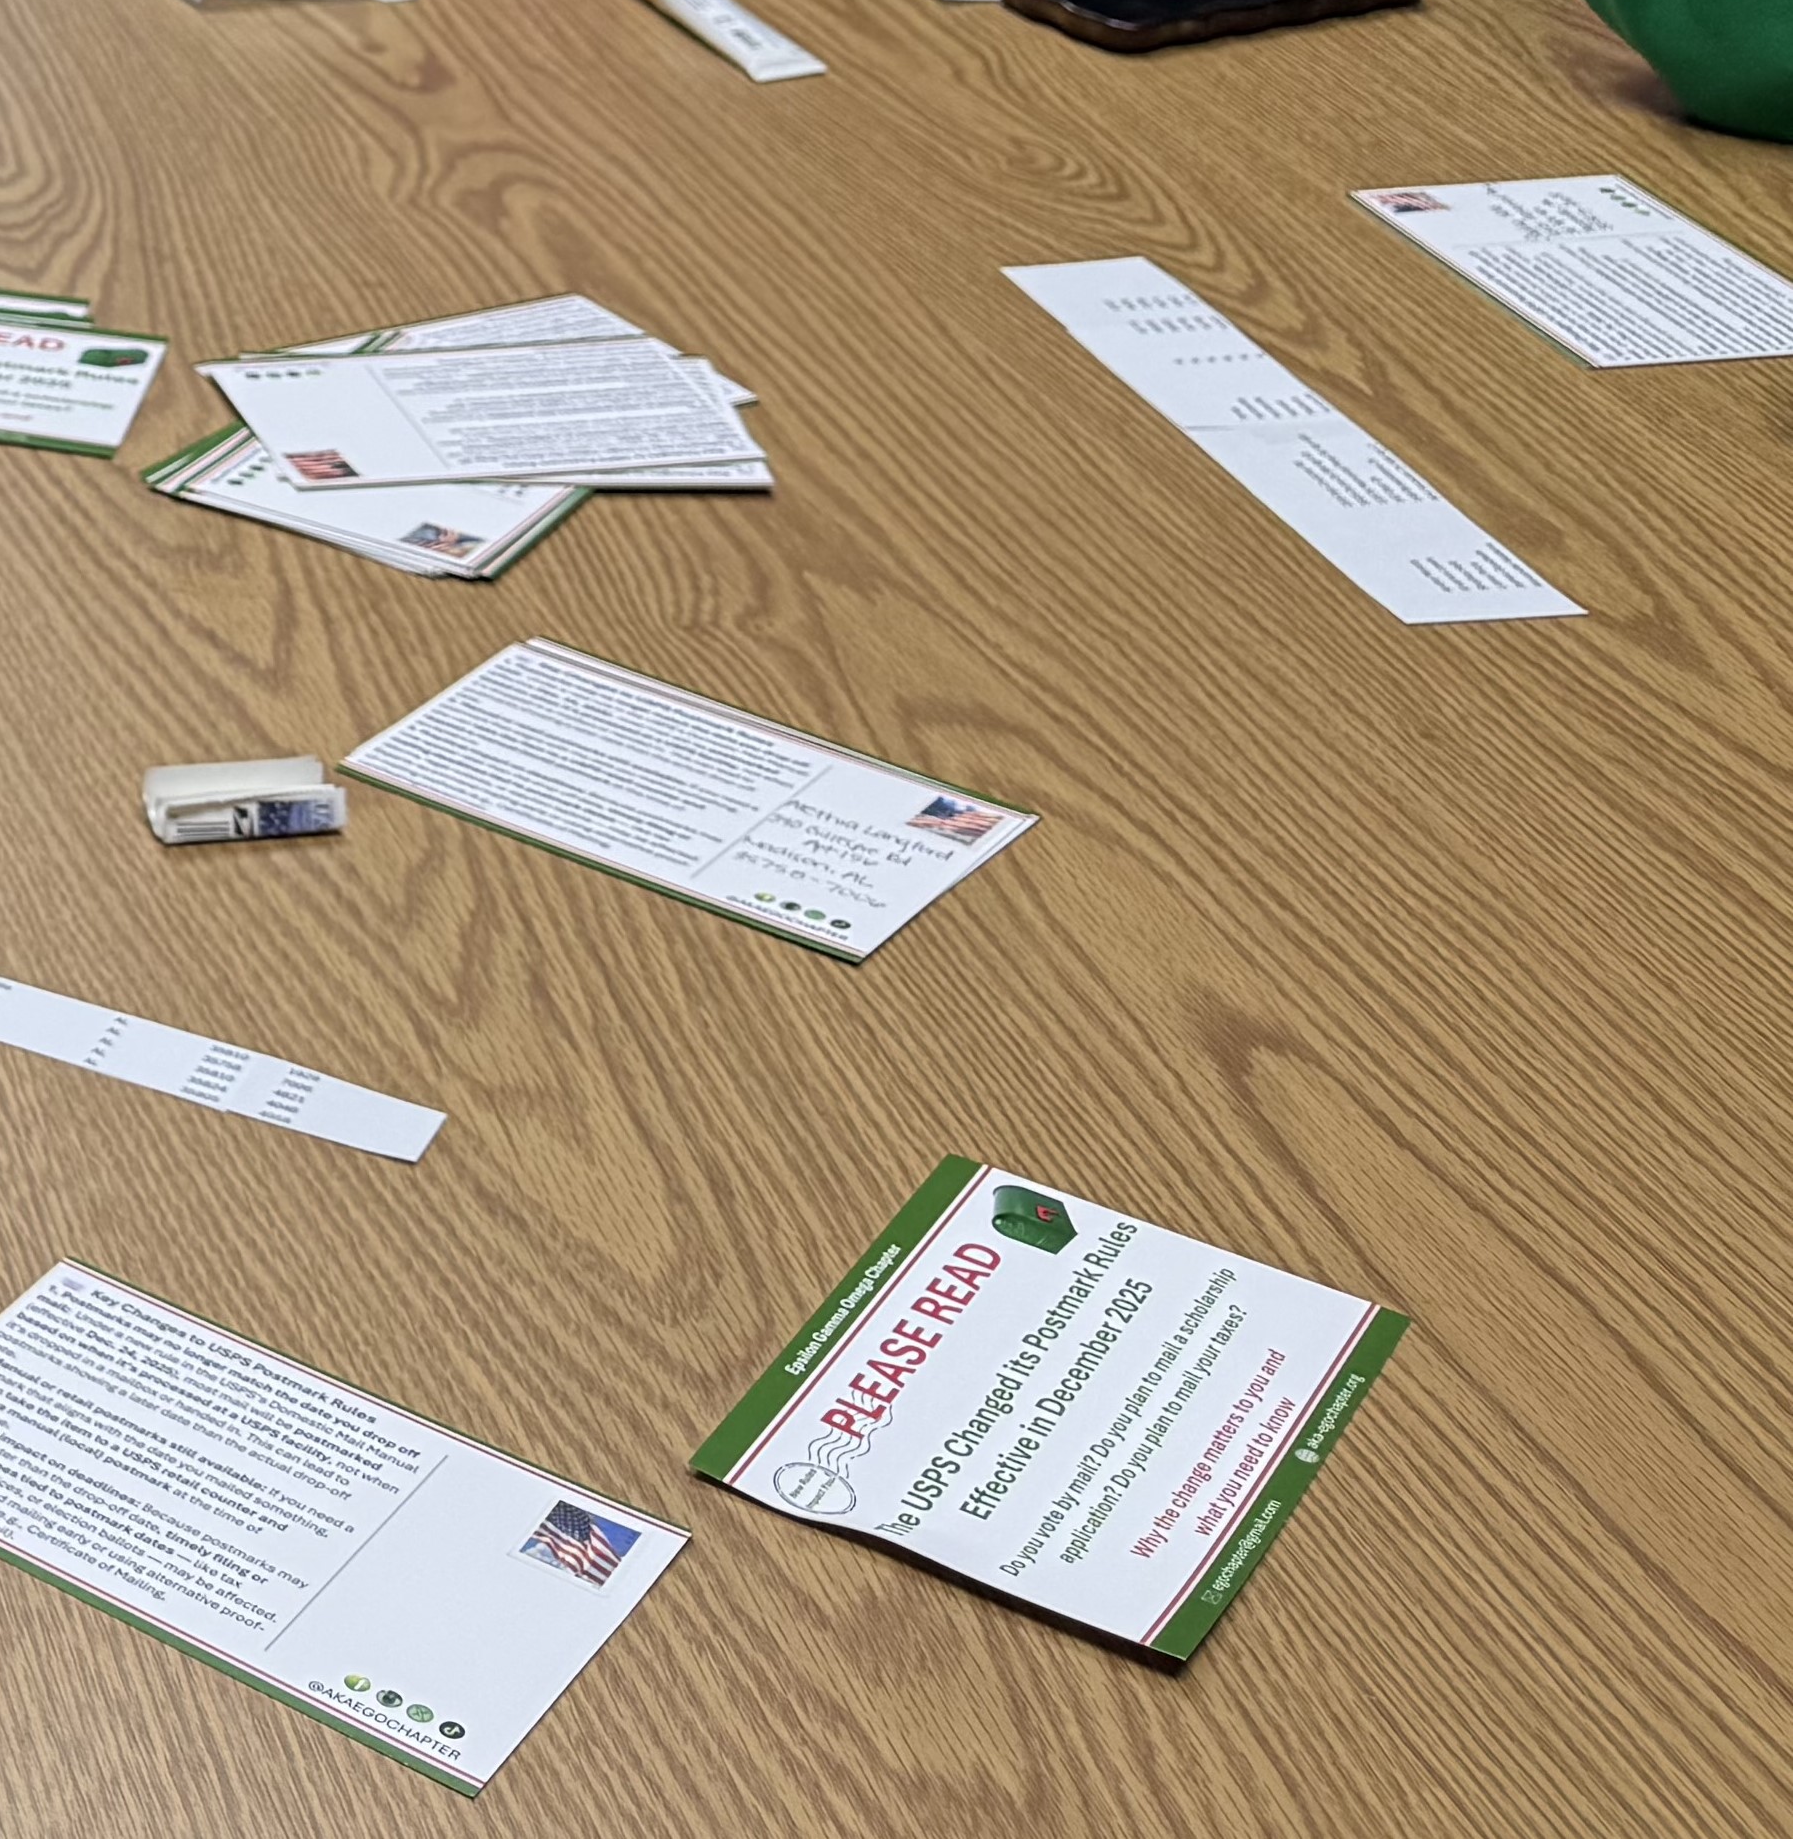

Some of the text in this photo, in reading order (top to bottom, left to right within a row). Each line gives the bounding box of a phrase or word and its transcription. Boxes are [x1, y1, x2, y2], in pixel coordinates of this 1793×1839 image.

[1082, 1221, 1137, 1269] Rules
[90, 1289, 120, 1306] Key
[120, 1303, 187, 1338] Changes
[207, 1342, 252, 1367] USPS
[251, 1362, 329, 1403] Postmark
[329, 1397, 376, 1423] Rules
[784, 1243, 901, 1375] Epsilon Gamma Omega Chapter
[821, 1242, 1003, 1440] PLEASE READ
[1002, 1351, 1041, 1376] its
[1021, 1267, 1104, 1351] Postmark
[16, 1310, 59, 1335] based
[77, 1340, 114, 1361] when
[114, 1357, 137, 1373] it's
[137, 1370, 213, 1407] processed
[240, 1414, 281, 1438] USPS
[335, 1460, 360, 1476] not
[361, 1472, 399, 1494] when
[60, 1290, 132, 1328] Postmarks
[132, 1325, 163, 1342] may
[182, 1346, 227, 1371] longer
[227, 1368, 273, 1392] match
[274, 1389, 298, 1404] the
[299, 1401, 333, 1419] date
[331, 1416, 360, 1432] you
[361, 1430, 396, 1448] drop
[397, 1446, 420, 1458] off
[943, 1372, 1023, 1456] Changed
[958, 1277, 1152, 1520] Effective in December 2025
[998, 1268, 1236, 1576] Do you vote by mail? Do you plan to mail a scholarship
[1059, 1304, 1247, 1563] application? Do you plan to mail your taxes?
[1306, 1373, 1365, 1449] aka-egochapter.org
[6, 1408, 60, 1437] manual
[58, 1433, 104, 1459] (local)
[102, 1455, 172, 1492] postmark
[189, 1495, 212, 1510] the
[212, 1507, 245, 1526] time
[56, 1388, 94, 1409] retail
[91, 1406, 167, 1445] postmarks
[168, 1442, 198, 1459] still
[277, 1493, 306, 1510] you
[306, 1507, 344, 1528] need
[900, 1455, 960, 1511] USPS
[1129, 1348, 1285, 1558] Why the change matters to you and
[1194, 1396, 1295, 1535] what you need to know
[6, 1499, 57, 1529] mailing
[56, 1524, 91, 1545] early
[107, 1550, 147, 1574] using
[145, 1569, 220, 1610] alternative
[141, 1502, 201, 1536] Because
[200, 1533, 276, 1573] postmarks
[277, 1570, 309, 1588] may
[1211, 1499, 1281, 1591] egochapter@gmail.com
[308, 1680, 460, 1760] @AKAEGOCHAPTER
